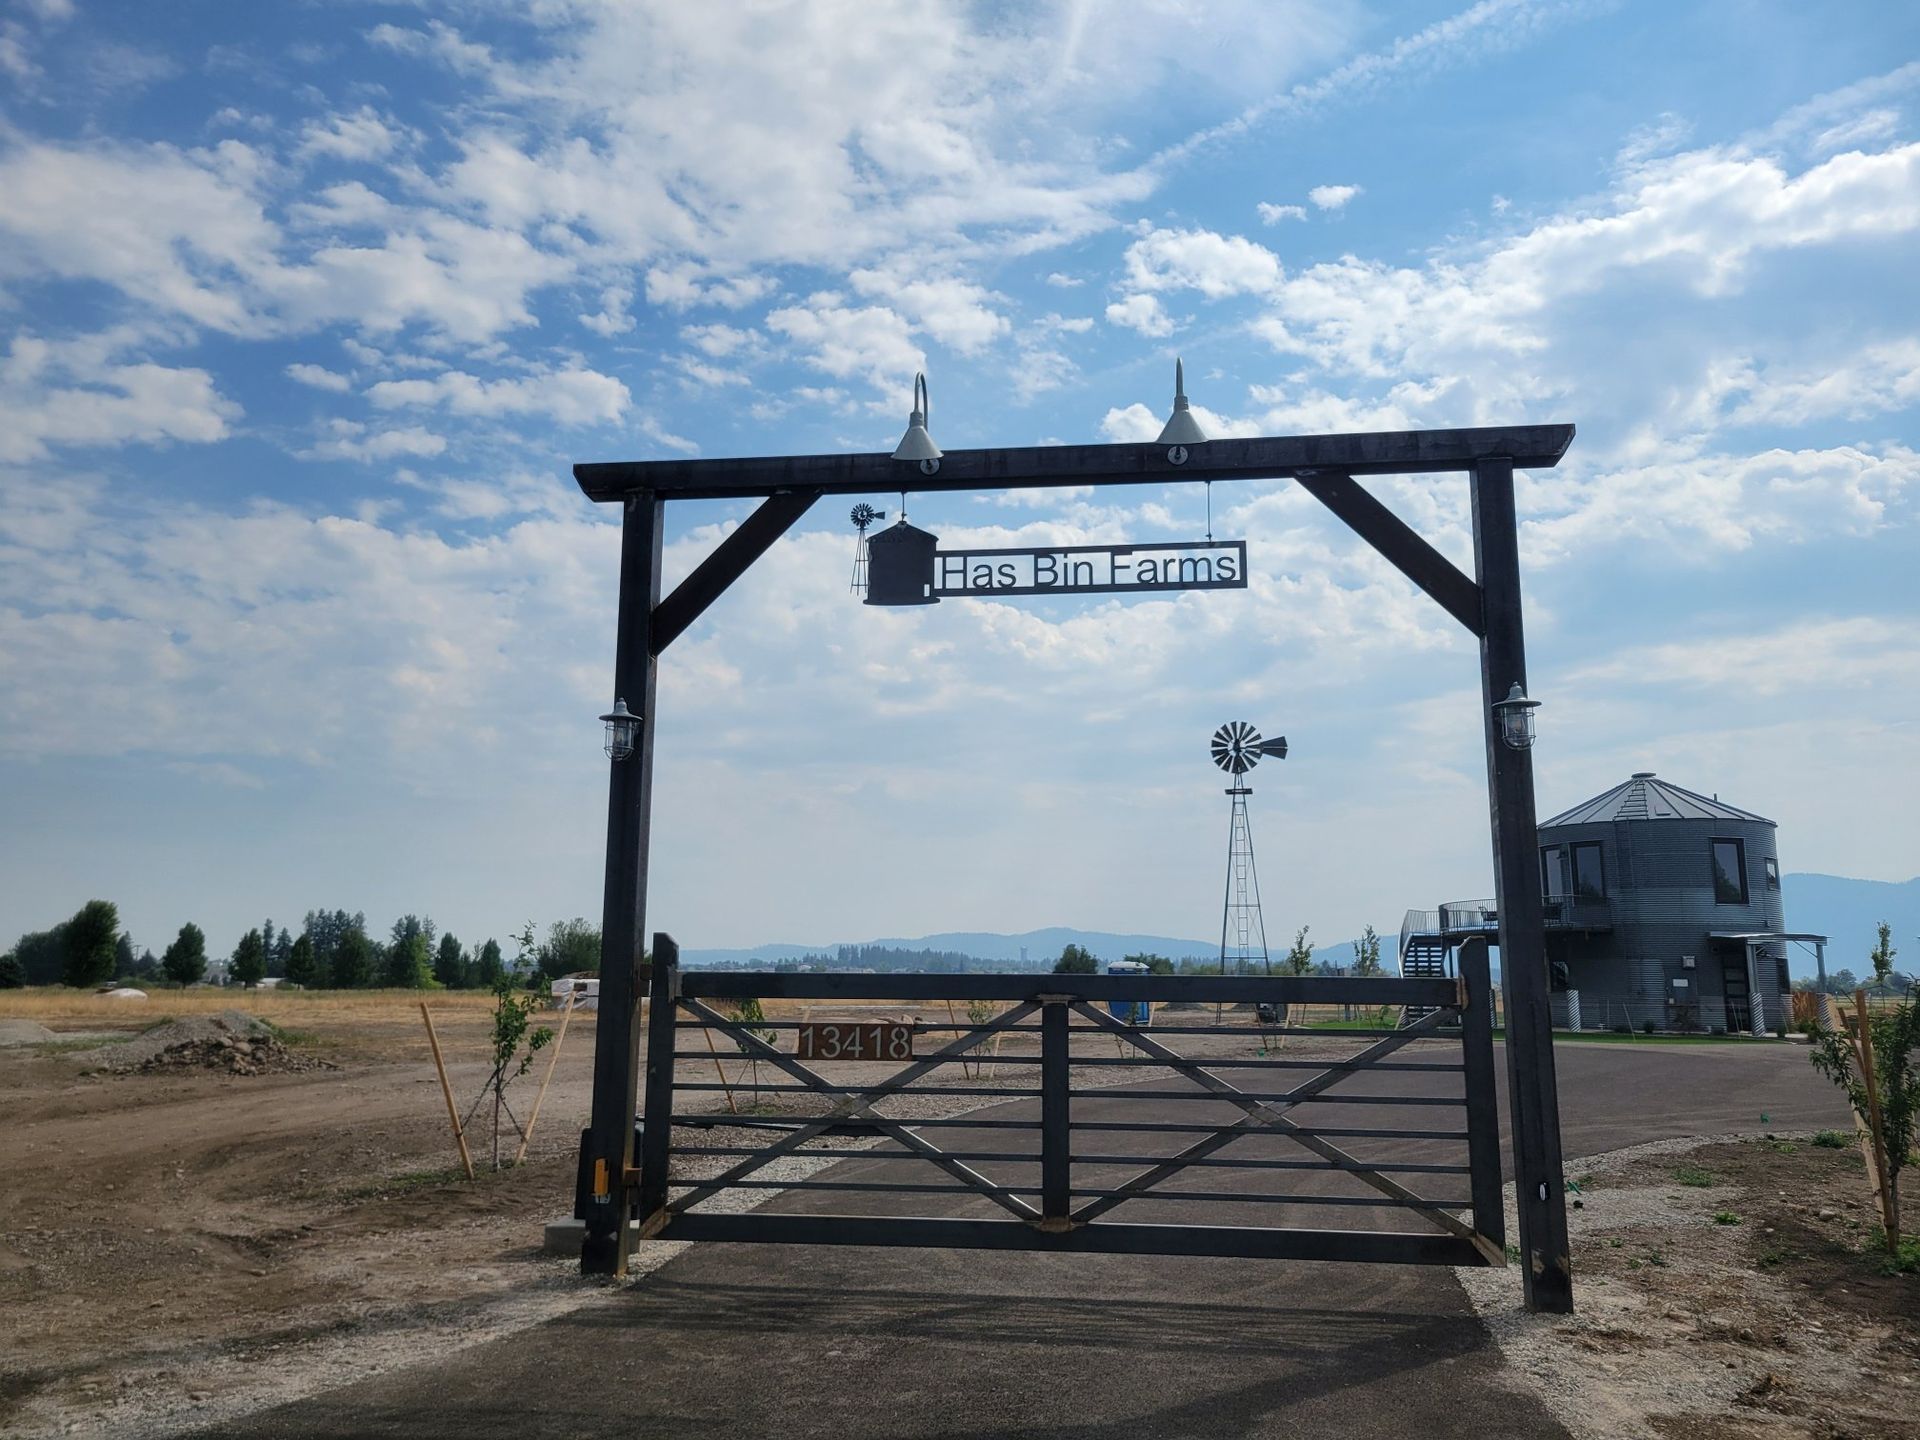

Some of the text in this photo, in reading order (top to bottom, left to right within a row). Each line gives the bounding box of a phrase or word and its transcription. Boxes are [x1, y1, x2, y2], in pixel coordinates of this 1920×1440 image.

[943, 550, 1236, 589] Has Bin Farms
[801, 1025, 910, 1059] 13418
